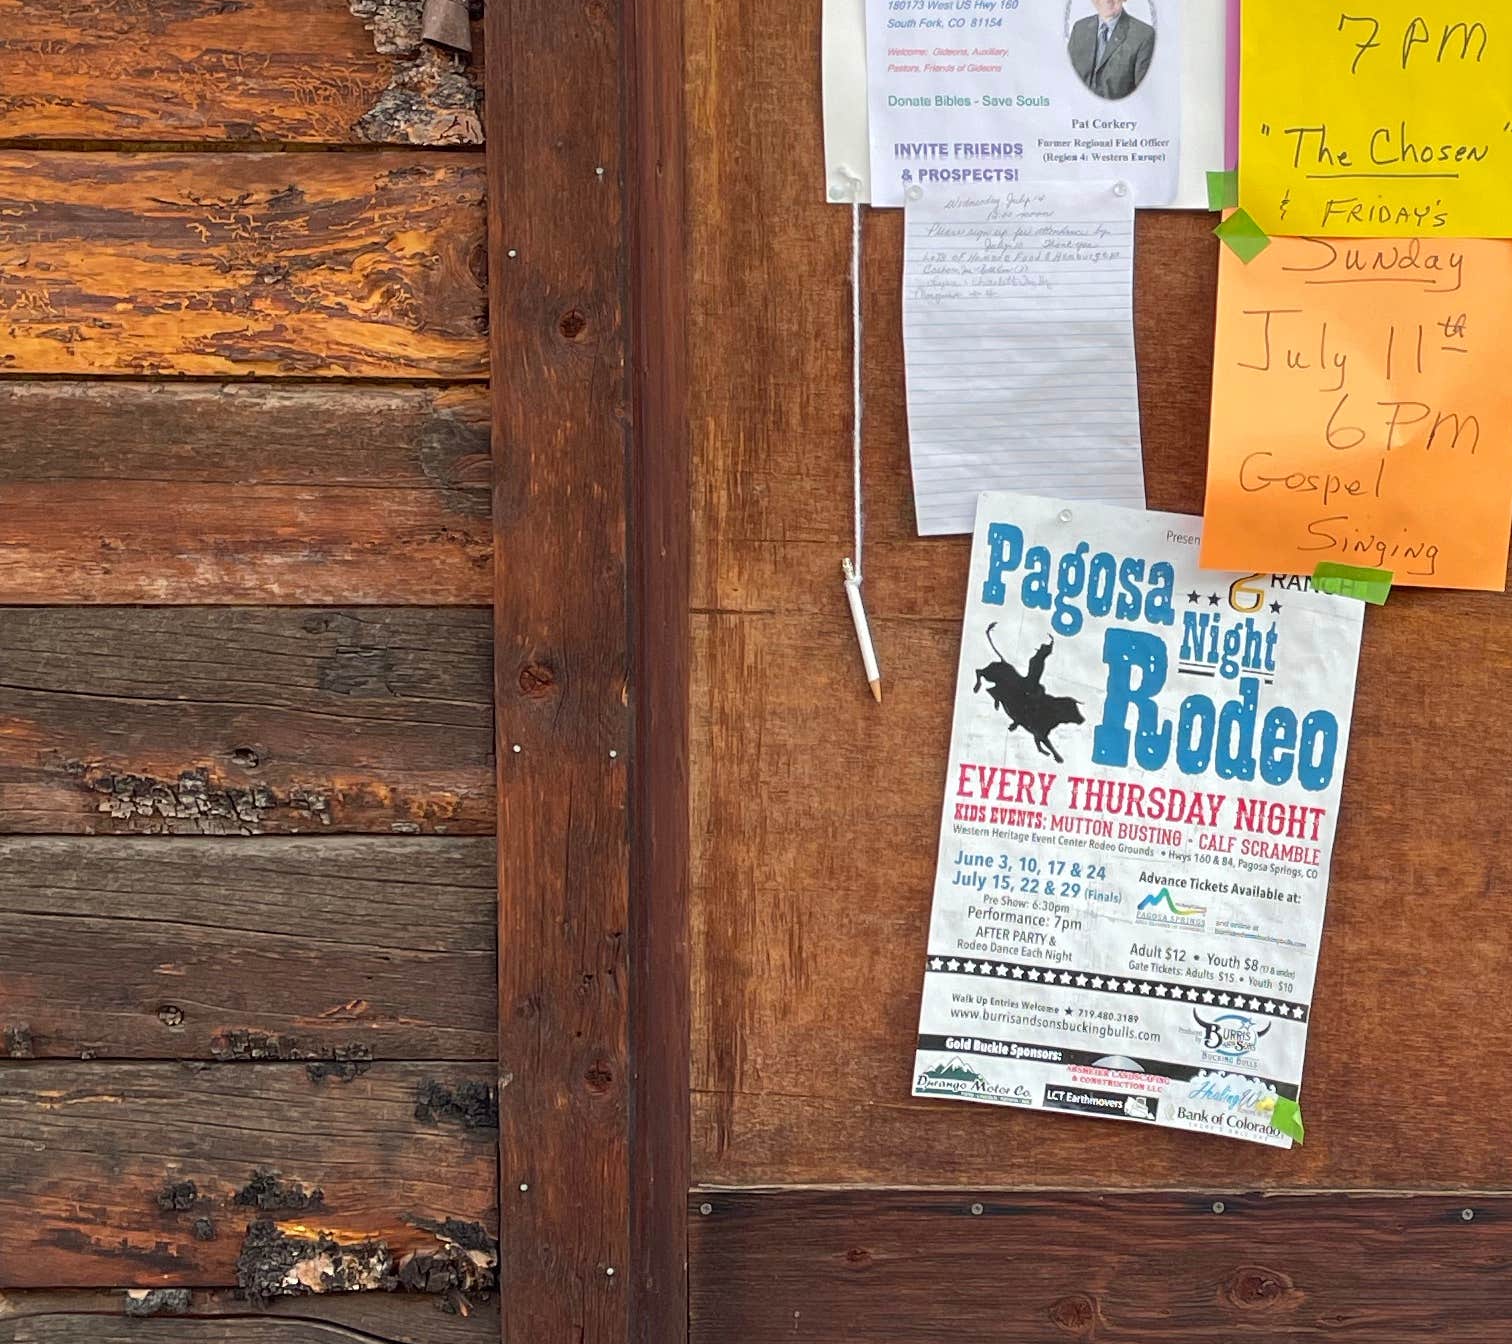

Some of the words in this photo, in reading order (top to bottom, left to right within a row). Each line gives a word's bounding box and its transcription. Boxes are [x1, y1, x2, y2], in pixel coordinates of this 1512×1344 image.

[887, 19, 916, 28] South
[919, 18, 944, 28] Fork,
[948, 18, 965, 28] CO
[1338, 13, 1380, 74] 7
[1402, 17, 1488, 69] PM
[888, 96, 931, 106] Donate
[935, 95, 971, 106] Bibles
[982, 95, 1012, 106] Save
[1016, 95, 1049, 106] Souls
[1072, 120, 1089, 129] Pat
[1092, 119, 1137, 131] Corkery
[894, 144, 948, 155] INVITE
[954, 144, 1023, 155] FRIENDS
[902, 170, 912, 181] &
[918, 169, 1019, 181] PROSPECTS!
[1282, 236, 1464, 292] Sunday
[1238, 310, 1347, 392] July
[1325, 394, 1365, 450] 6
[1239, 451, 1385, 505] Gospel
[1297, 516, 1439, 575] Singing
[980, 522, 1176, 638] Pagosa
[1180, 609, 1279, 681] Night
[1091, 627, 1338, 791] Rodeo
[956, 763, 1058, 807] EVERY
[1067, 776, 1227, 826] THURSDAY
[1234, 797, 1326, 841] NIGHT
[954, 803, 986, 823] KIDS
[989, 808, 1047, 830] EVENTS:
[1050, 815, 1113, 837] MUTTON
[1118, 823, 1182, 847] BUSTING
[1199, 834, 1236, 853] CALF
[1241, 839, 1321, 866] SCRAMBLE
[954, 851, 993, 868] June
[998, 855, 1012, 872] 3,
[1019, 857, 1041, 875] 10,
[1048, 861, 1066, 875] 17
[1070, 864, 1081, 877] &
[1086, 865, 1106, 881] 24
[952, 871, 987, 892] July
[993, 875, 1014, 892] 15,
[1020, 878, 1039, 893] 22
[1044, 881, 1056, 895] &
[1060, 883, 1081, 898] 29
[1084, 888, 1121, 905] (Finals)
[1139, 872, 1187, 888] Advance
[1190, 879, 1228, 894] Tickets
[1231, 884, 1283, 902] Available
[1286, 893, 1302, 904] at:
[967, 906, 1050, 927] Performance:
[1054, 916, 1082, 931] 7pm
[1130, 943, 1161, 960] Adult
[1165, 947, 1186, 962] $12
[1207, 953, 1240, 969] Youth
[1244, 957, 1259, 972] $8
[946, 1037, 972, 1051] Gold
[973, 1040, 1009, 1055] Buckle
[1010, 1045, 1062, 1061] Sponsors:
[1177, 1107, 1210, 1123] Bank
[1211, 1112, 1224, 1124] of
